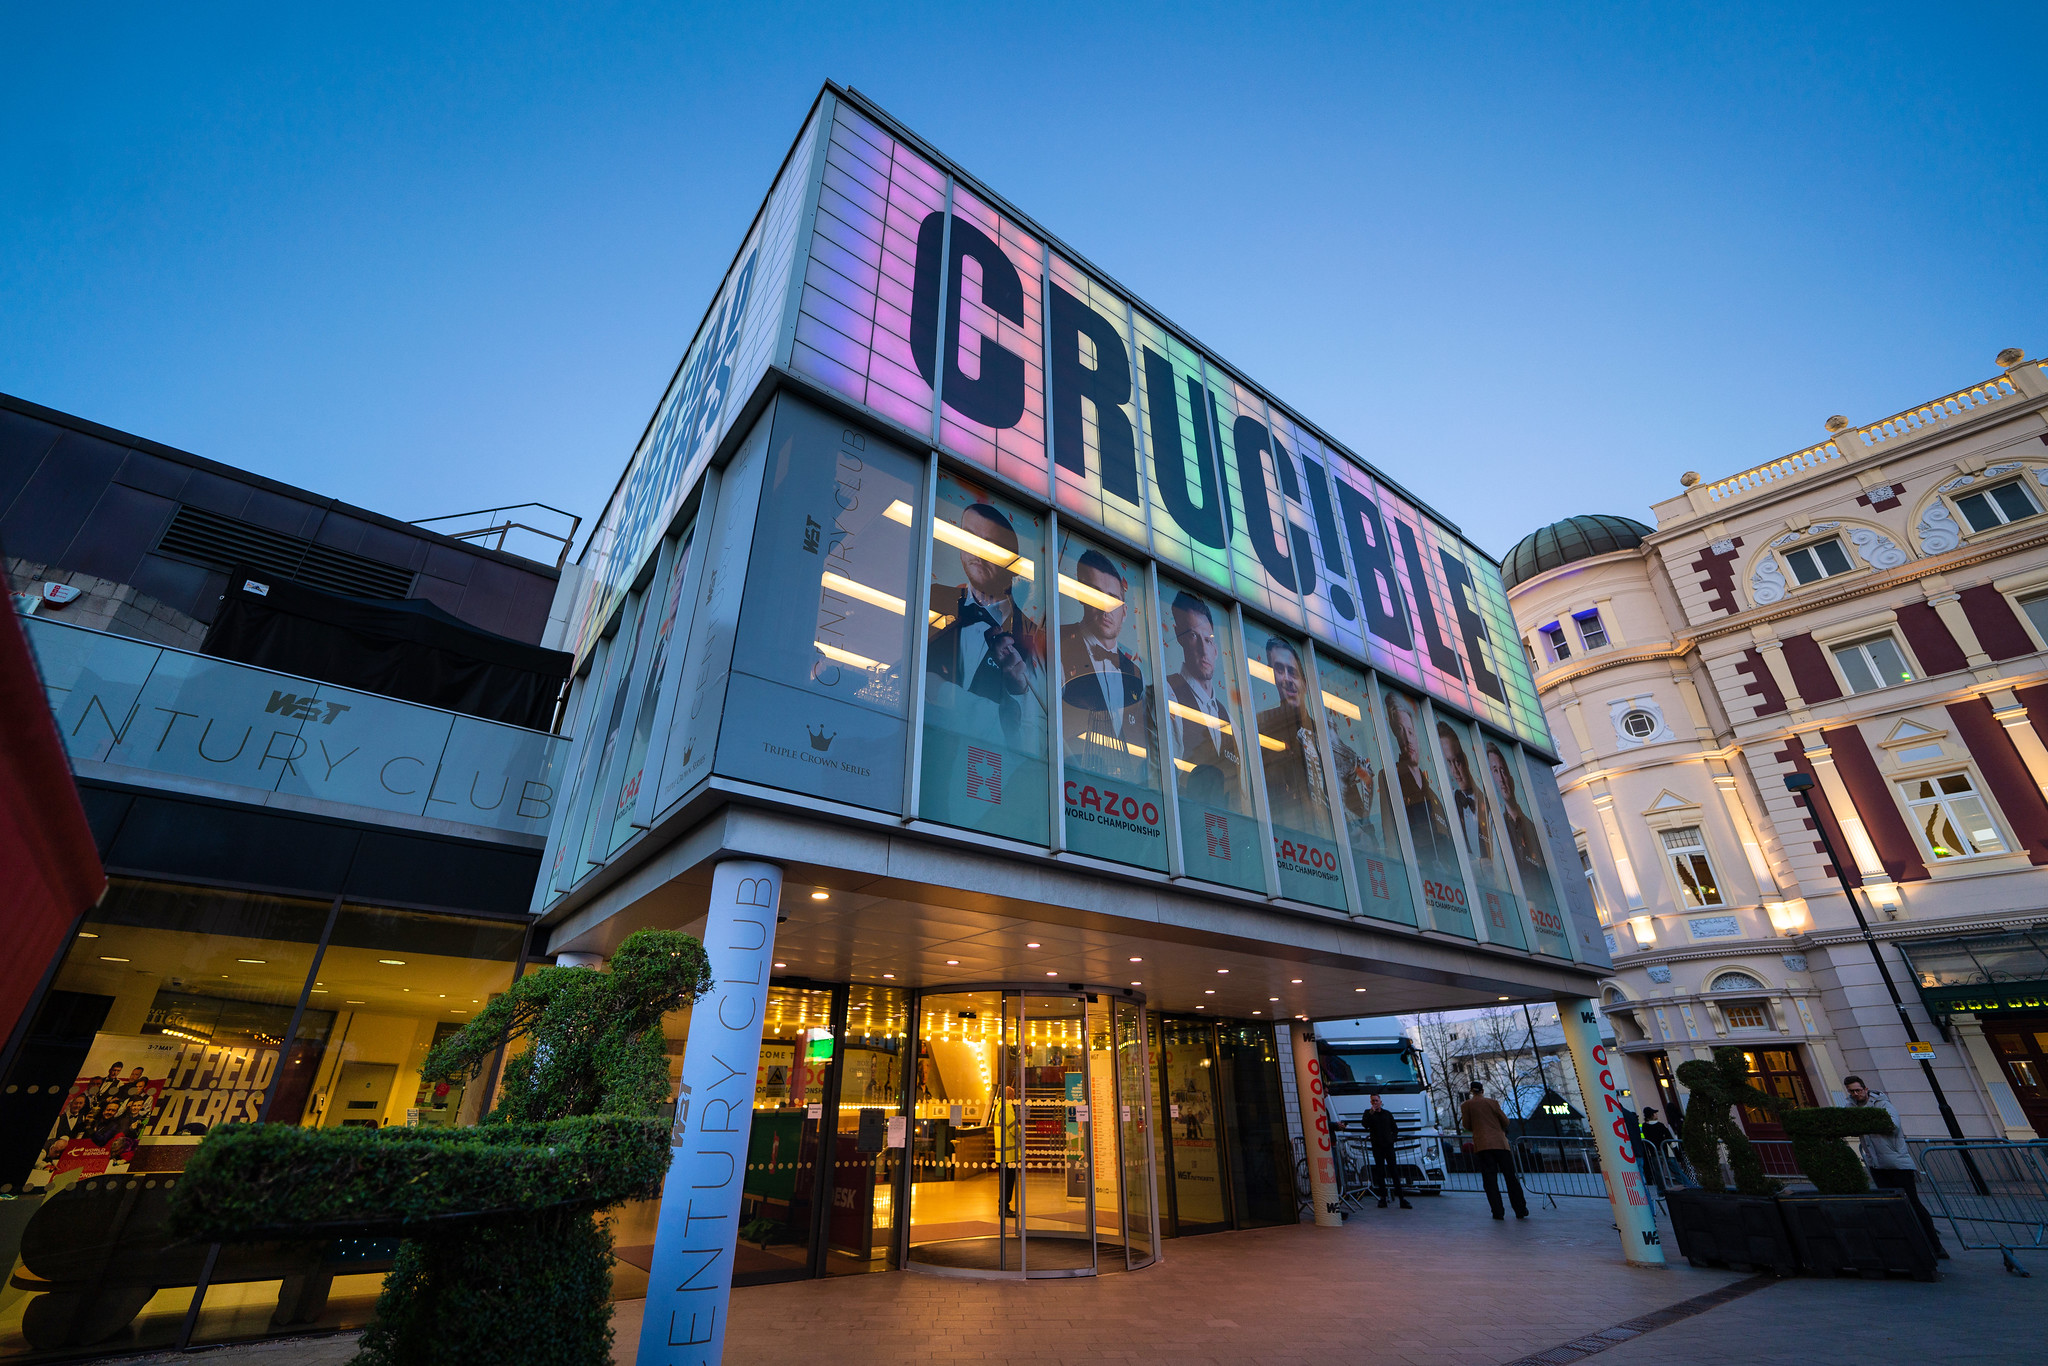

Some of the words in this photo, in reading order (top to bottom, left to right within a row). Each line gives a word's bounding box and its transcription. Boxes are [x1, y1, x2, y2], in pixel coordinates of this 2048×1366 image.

[803, 514, 822, 555] WST
[813, 517, 855, 687] CENTURY
[835, 429, 866, 512] CLUB
[265, 690, 351, 725] WST
[763, 742, 798, 759] TRIPLE
[800, 751, 838, 769] CROWN
[840, 762, 871, 777] SERIES
[380, 755, 553, 820] CLUB
[1064, 781, 1159, 826] CAZOO
[1065, 807, 1095, 822] WORLD
[1097, 816, 1160, 838] CHAMPIONSHIP
[1295, 865, 1338, 881] CHAMPIONSHIP
[719, 877, 772, 1031] CLUB
[1307, 1058, 1331, 1152] CAZOO
[1593, 1045, 1636, 1164] CAZOO
[833, 1187, 857, 1209] ESK
